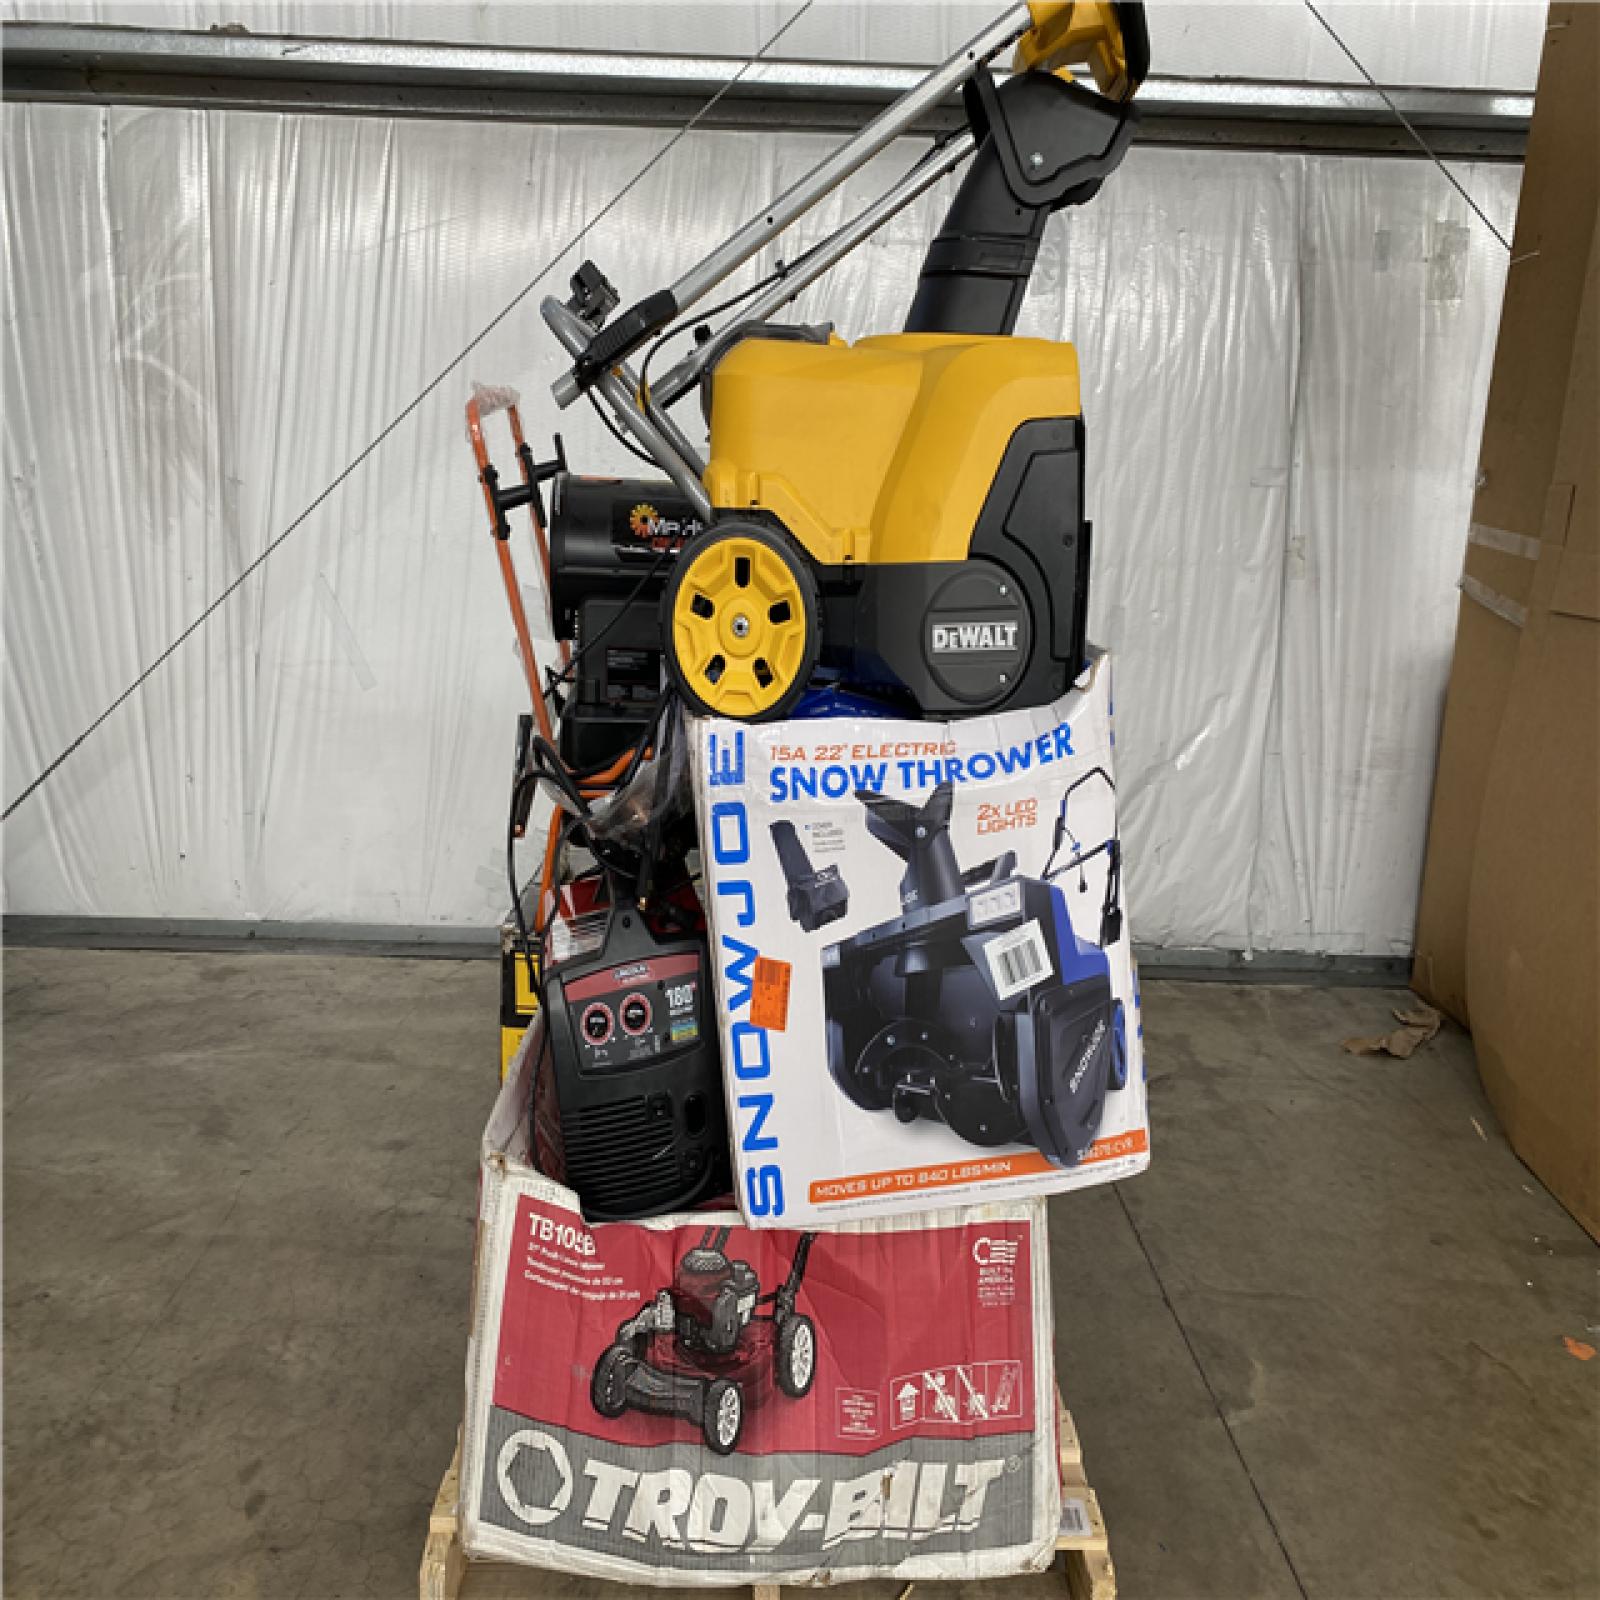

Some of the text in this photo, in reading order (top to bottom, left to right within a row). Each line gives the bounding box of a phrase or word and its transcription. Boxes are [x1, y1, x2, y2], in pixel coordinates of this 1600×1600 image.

[769, 721, 1076, 803] SNOW THROWER
[770, 744, 806, 761] 15A
[852, 740, 957, 758] ELECTRIC
[1004, 797, 1039, 817] LED
[976, 814, 1037, 836] LIGHTS
[814, 1178, 867, 1198] MOVES
[872, 1175, 894, 1193] UP
[896, 1172, 915, 1189] TO
[581, 1458, 1006, 1554] TROY-BILT
